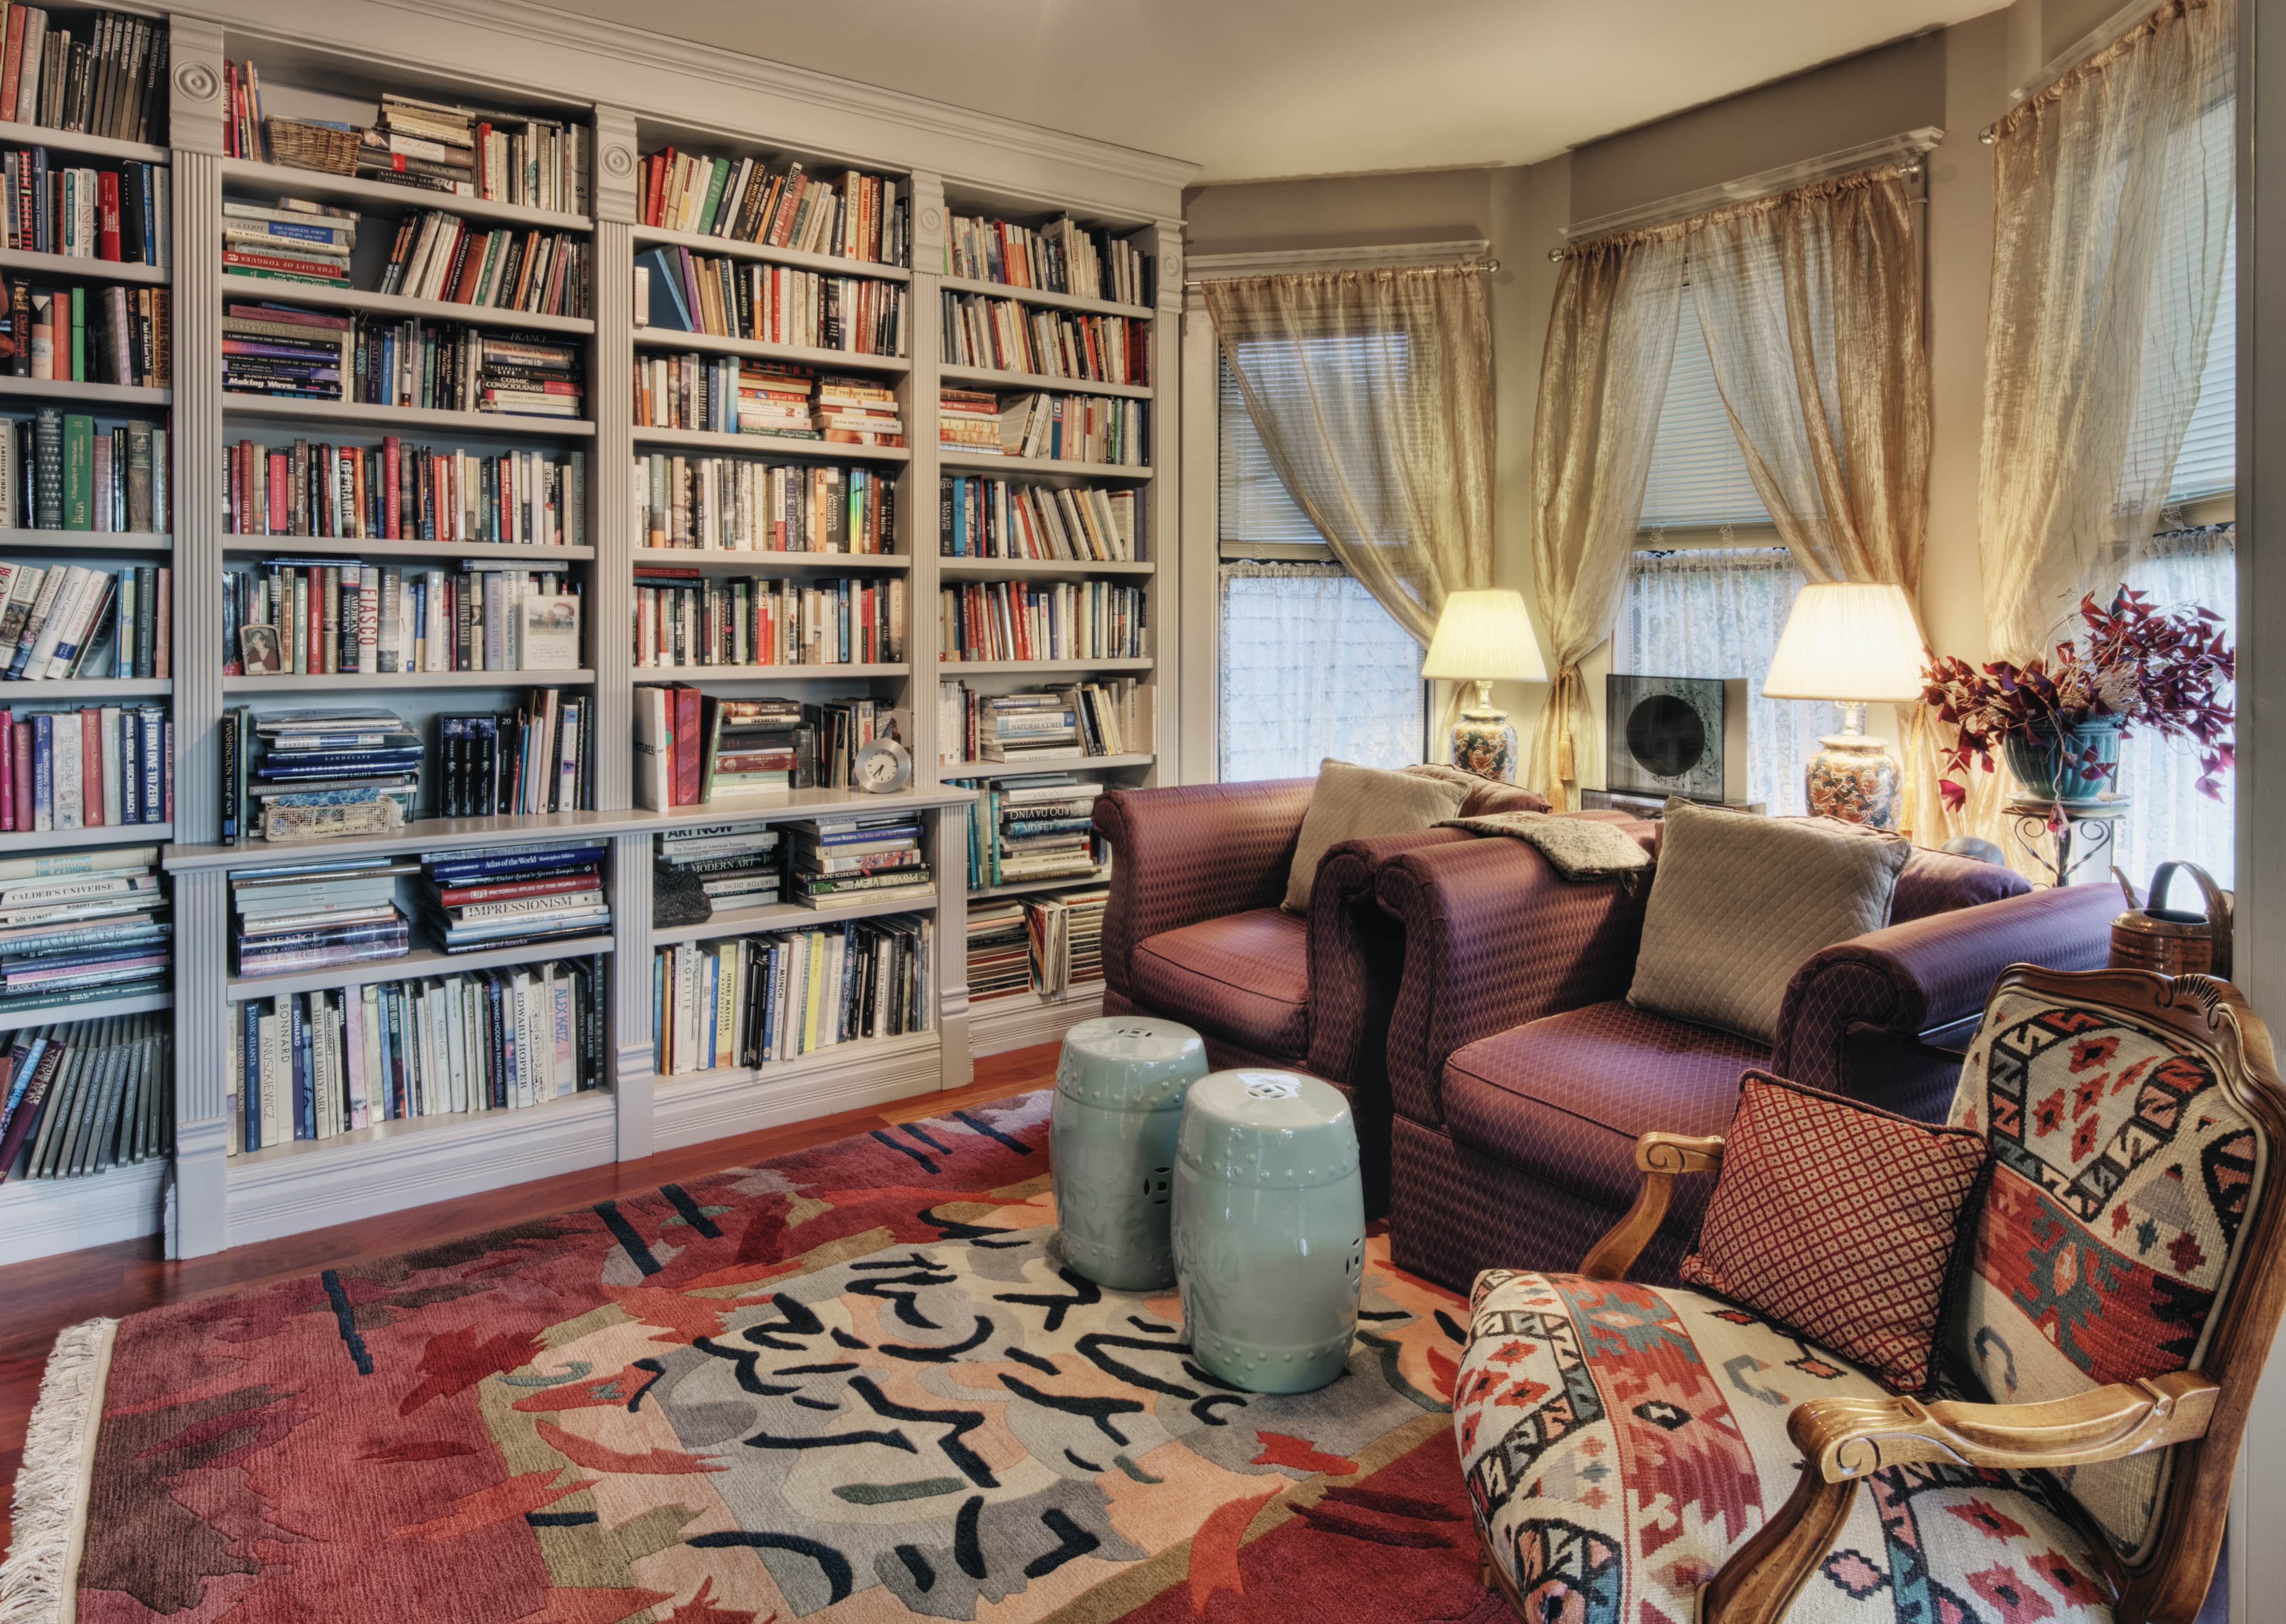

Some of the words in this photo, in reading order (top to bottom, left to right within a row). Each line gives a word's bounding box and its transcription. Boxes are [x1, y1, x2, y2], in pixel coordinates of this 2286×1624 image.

[756, 165, 765, 182] COLD
[786, 168, 801, 194] KOSINSKI
[745, 184, 759, 216] MOUNTAIN
[82, 205, 91, 244] INSECTS
[241, 256, 279, 267] TONGUES
[505, 263, 514, 282] SONTAG
[159, 294, 170, 336] MICHAEL
[511, 332, 548, 343] FRANCE
[159, 339, 170, 380] CHABON
[229, 378, 265, 388] Making
[267, 381, 296, 389] Waves
[486, 382, 543, 392] CONSCIOUSNESS
[341, 459, 352, 482] OFF
[342, 486, 353, 517] RAMP
[576, 492, 583, 501] OF
[15, 568, 30, 598] COURAGE
[66, 580, 80, 601] Natural
[53, 602, 71, 631] Capitalism
[360, 589, 377, 645] FIASCO
[459, 593, 469, 620] NOTHING
[460, 622, 469, 645] SACRED
[147, 724, 157, 750] FROM
[567, 726, 575, 759] evolution
[65, 736, 74, 787] SHAKESPEARE
[148, 752, 157, 769] ONE
[148, 771, 158, 782] TO
[148, 783, 159, 807] ZERO
[1010, 810, 1034, 819] VINCI
[668, 829, 694, 838] ART
[697, 825, 732, 835] NOW
[1024, 824, 1053, 832] MONET
[519, 857, 536, 865] World
[691, 861, 734, 873] MODERN
[737, 859, 754, 867] ART
[855, 878, 879, 889] VIEW
[881, 874, 917, 885] PRIVATE
[12, 890, 60, 901] CALDER'S
[63, 883, 114, 896] UNIVERSE
[469, 896, 572, 918] IMPRESSIONISM
[0, 936, 67, 952] WILLIAM
[73, 931, 121, 943] BLAKE
[266, 932, 320, 945] VENICE
[6, 984, 35, 993] ALASKA
[555, 989, 567, 1015] ALEX
[517, 992, 526, 1040] EDWARD
[280, 1004, 290, 1062] BONNARD
[556, 1016, 568, 1043] KATZ
[315, 1047, 322, 1058] OF
[24, 1048, 56, 1103] NAPOLEON
[42, 1069, 53, 1082] THE
[315, 1061, 324, 1083] EMILY
[518, 1044, 527, 1089] HOPPER
[263, 1037, 274, 1119] ANUSZKIEWICZ
[34, 1094, 42, 1105] OF
[36, 1083, 47, 1096] AGE
[317, 1086, 325, 1113] CARR
